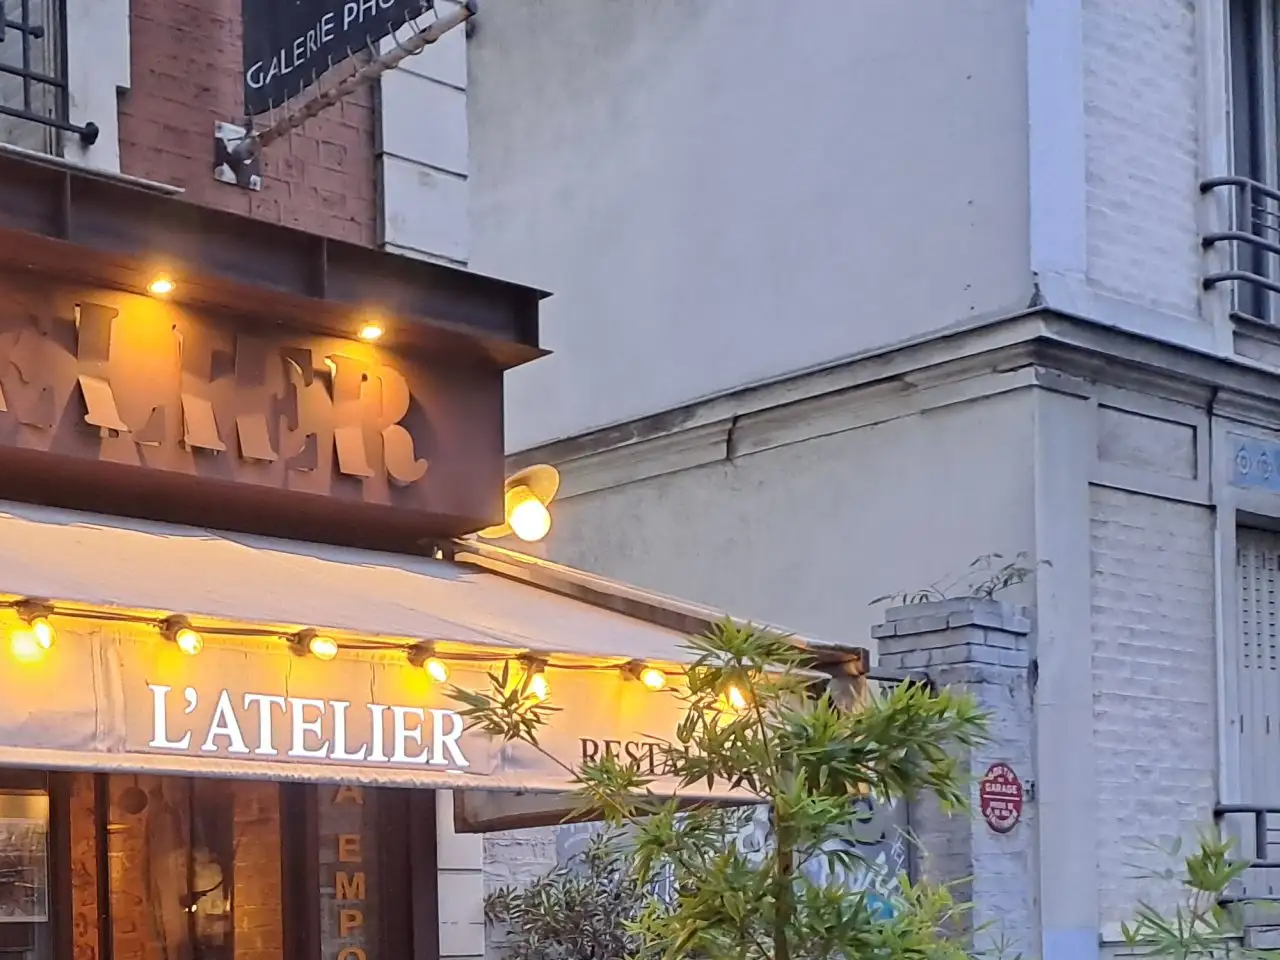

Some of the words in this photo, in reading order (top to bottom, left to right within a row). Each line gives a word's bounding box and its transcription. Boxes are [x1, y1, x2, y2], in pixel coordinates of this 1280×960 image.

[246, 12, 336, 89] GALERIE
[343, 0, 395, 31] PH
[147, 683, 471, 768] L'ATELIER
[985, 782, 1018, 794] GARAGE
